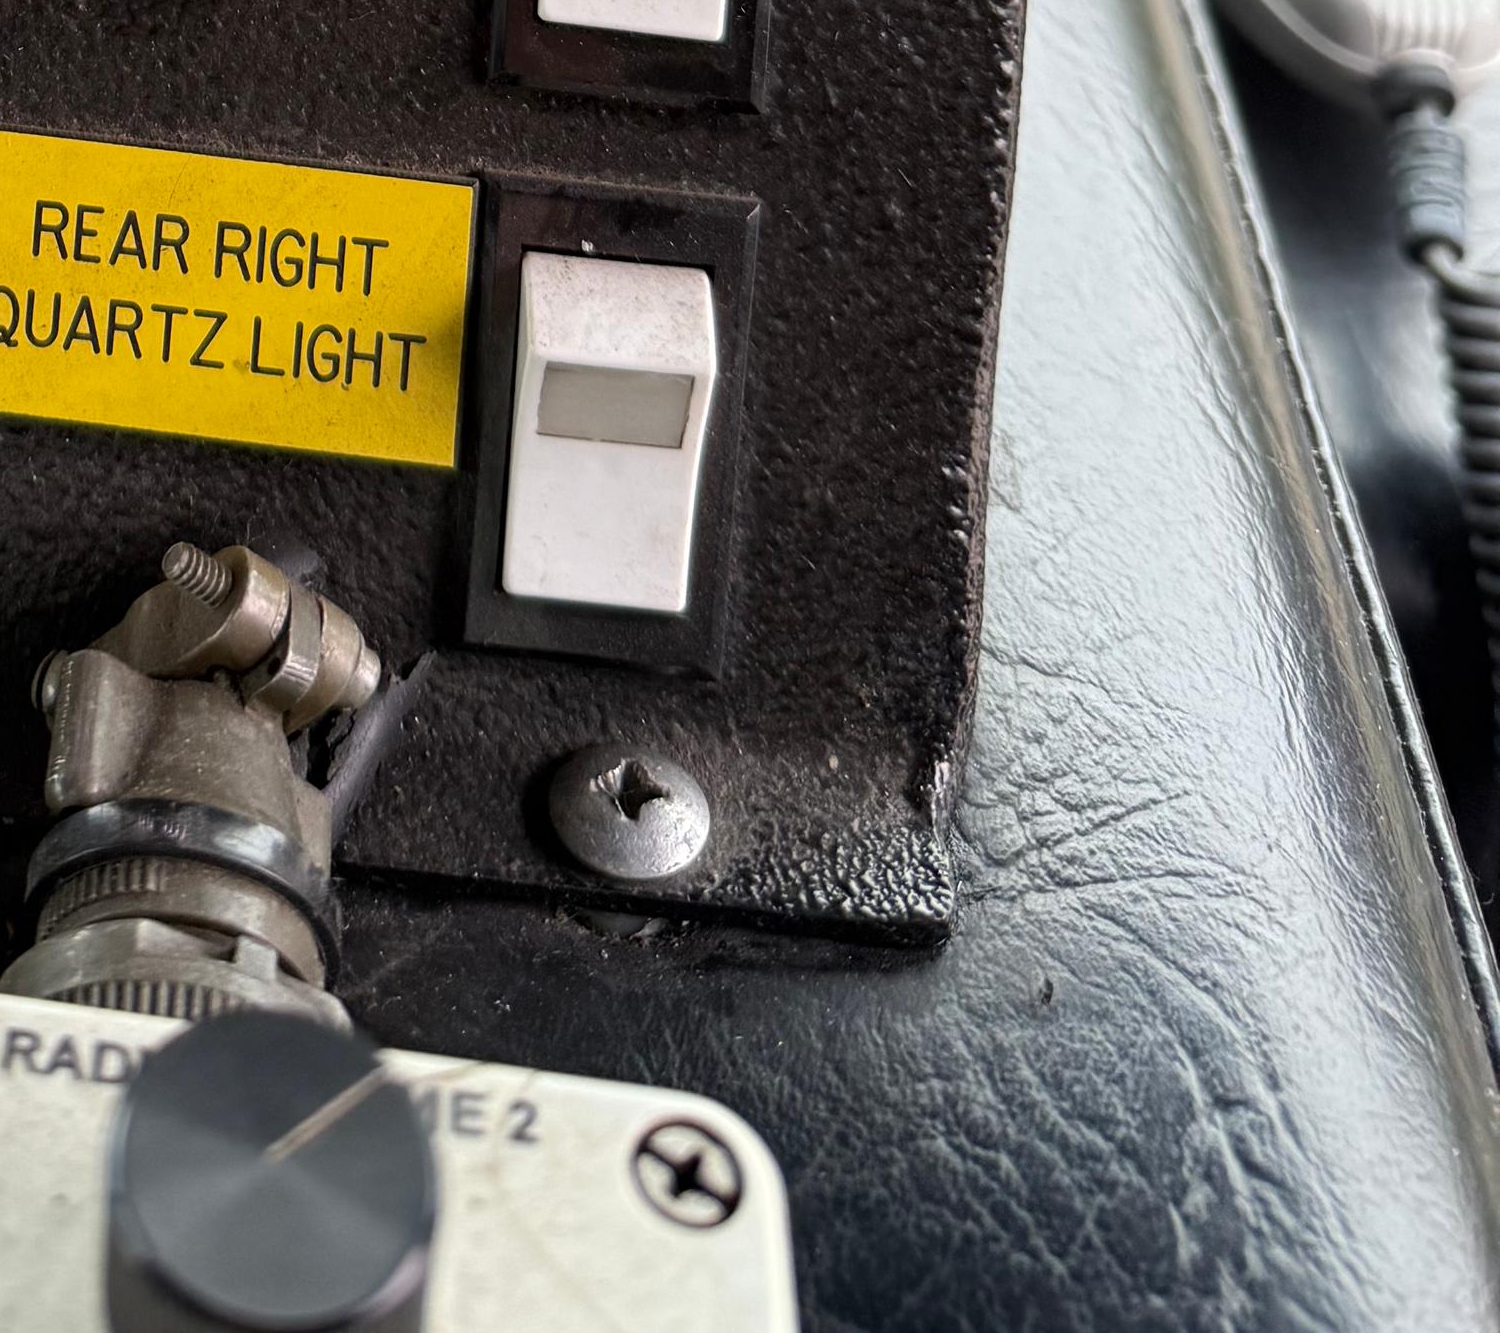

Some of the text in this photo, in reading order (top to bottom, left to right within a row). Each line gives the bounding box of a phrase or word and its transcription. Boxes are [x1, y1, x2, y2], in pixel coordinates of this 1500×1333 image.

[31, 199, 389, 297] REAR RIGHT
[251, 316, 427, 392] LIGHT
[508, 1098, 540, 1144] 2
